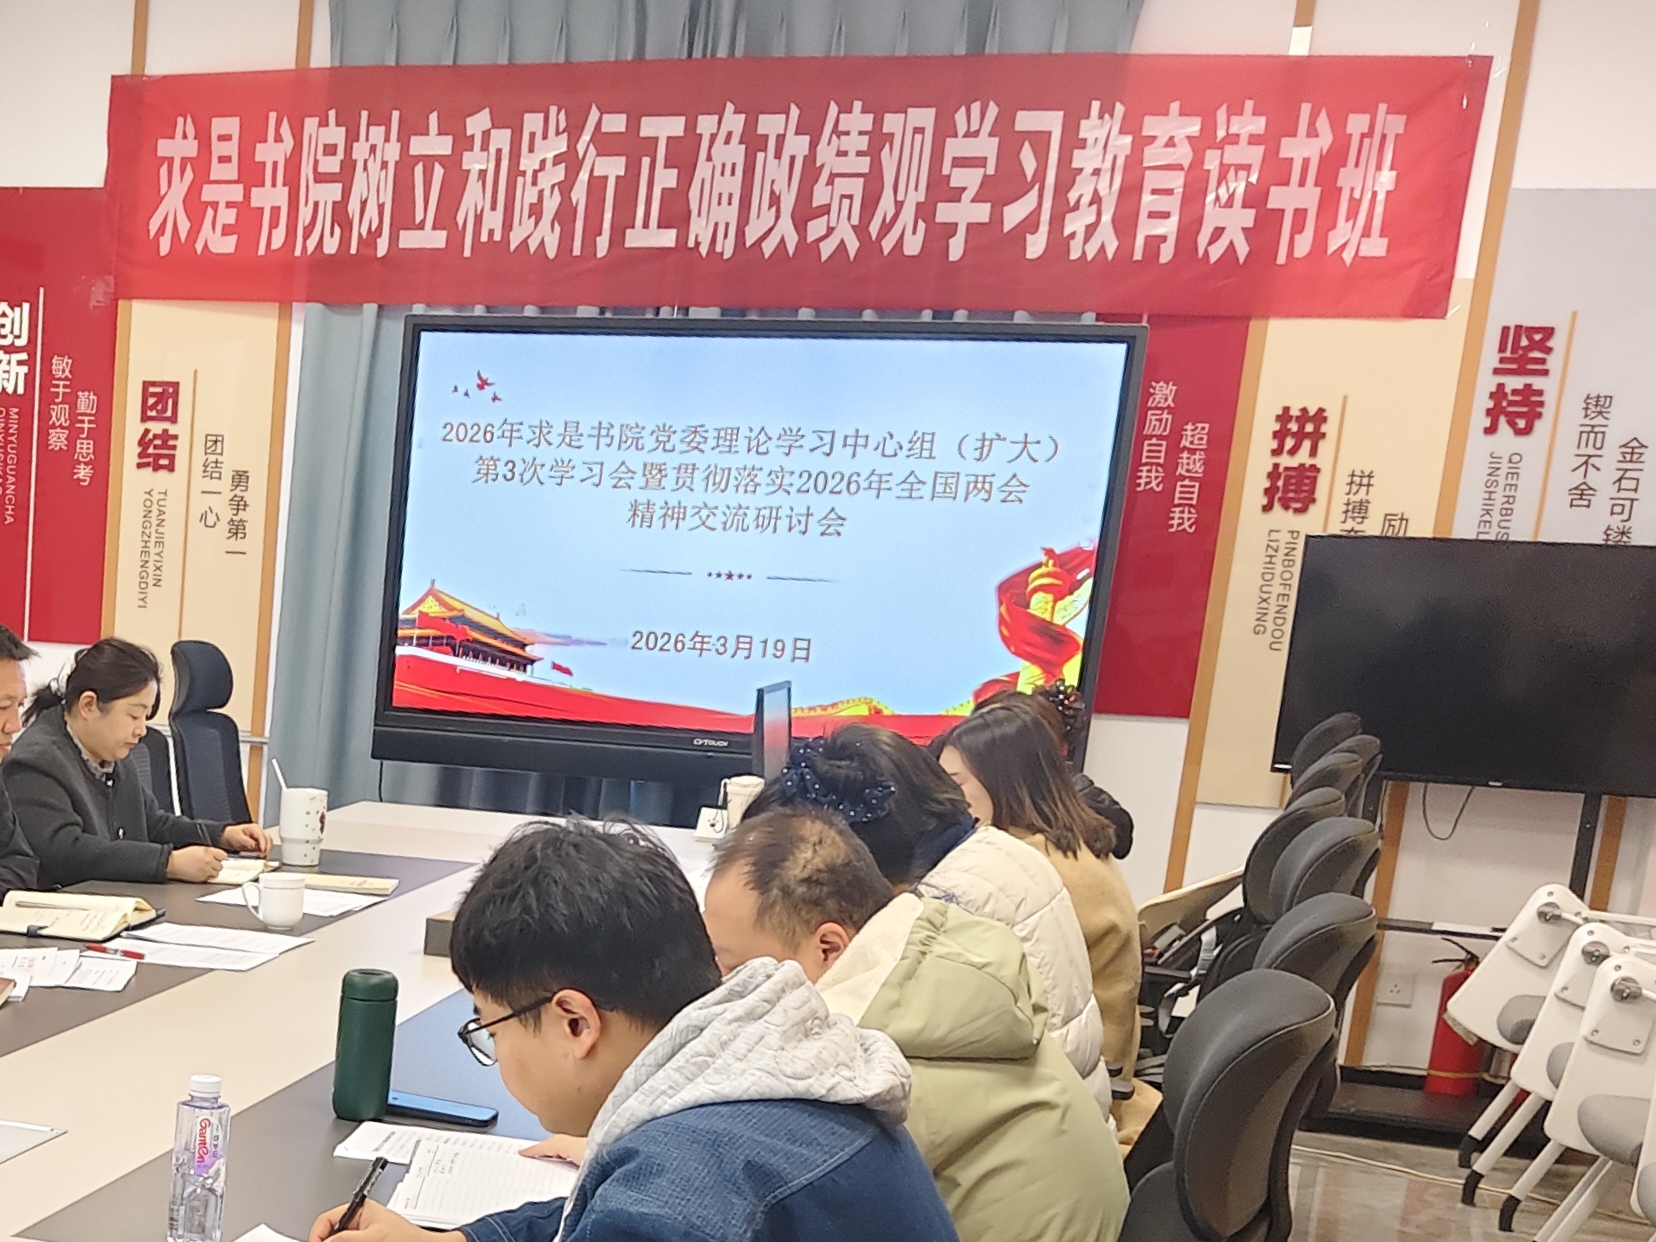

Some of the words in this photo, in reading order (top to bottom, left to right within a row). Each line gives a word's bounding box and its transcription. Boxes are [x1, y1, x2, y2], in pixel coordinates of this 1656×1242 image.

[149, 100, 1406, 266] 求是书院树立和践行正确政绩观学习教育读书班
[47, 355, 73, 451] 敏于观察
[136, 380, 180, 473] 团结
[1483, 324, 1555, 436] 坚持
[4, 407, 19, 525] MINYUGUANCHA
[73, 391, 98, 486] 勤于思考
[199, 433, 225, 529] 团结一心
[442, 418, 1059, 463] 2026年求是书院党委理论学习中心组(扩大)
[471, 454, 1030, 504] 第3次学习会暨贯彻落实2026年全国两会
[1135, 380, 1177, 492] 激励自我
[1168, 421, 1210, 533] 超越自我
[1261, 405, 1328, 514] 拼搏
[1568, 393, 1613, 509] 锲而不舍
[137, 488, 154, 609] YONGZHENGDIYI
[152, 489, 167, 588] TUANJIEYIXIN
[225, 469, 250, 555] 勇争第一
[626, 499, 847, 537] 精神交流研讨会
[1340, 469, 1374, 536] 拼搏
[1253, 529, 1281, 635] LIZHIDUXING
[1269, 530, 1300, 652] PINBOFENDOU
[631, 631, 811, 663] 2026年3月19日
